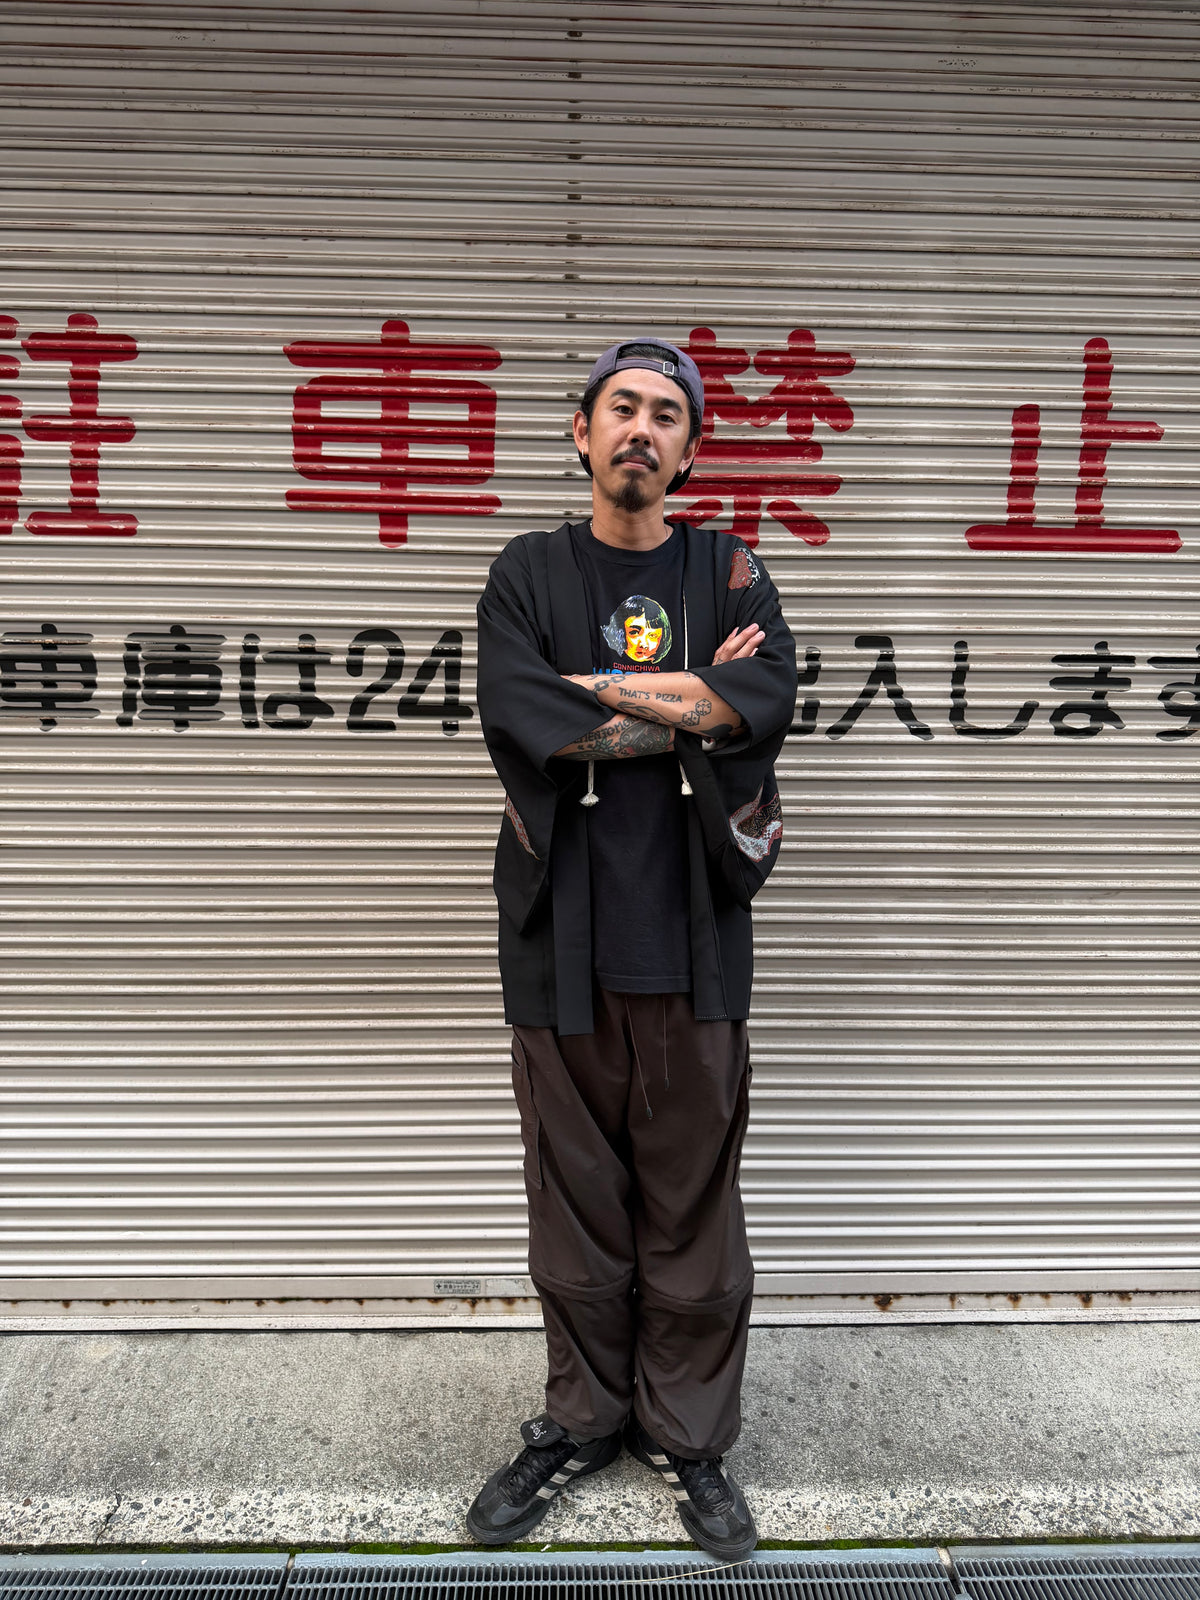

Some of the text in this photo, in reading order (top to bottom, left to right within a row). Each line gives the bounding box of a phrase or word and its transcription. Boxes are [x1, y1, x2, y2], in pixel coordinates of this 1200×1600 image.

[613, 662, 660, 672] CONNICHIWA
[618, 687, 682, 703] THAT'S PIZZA
